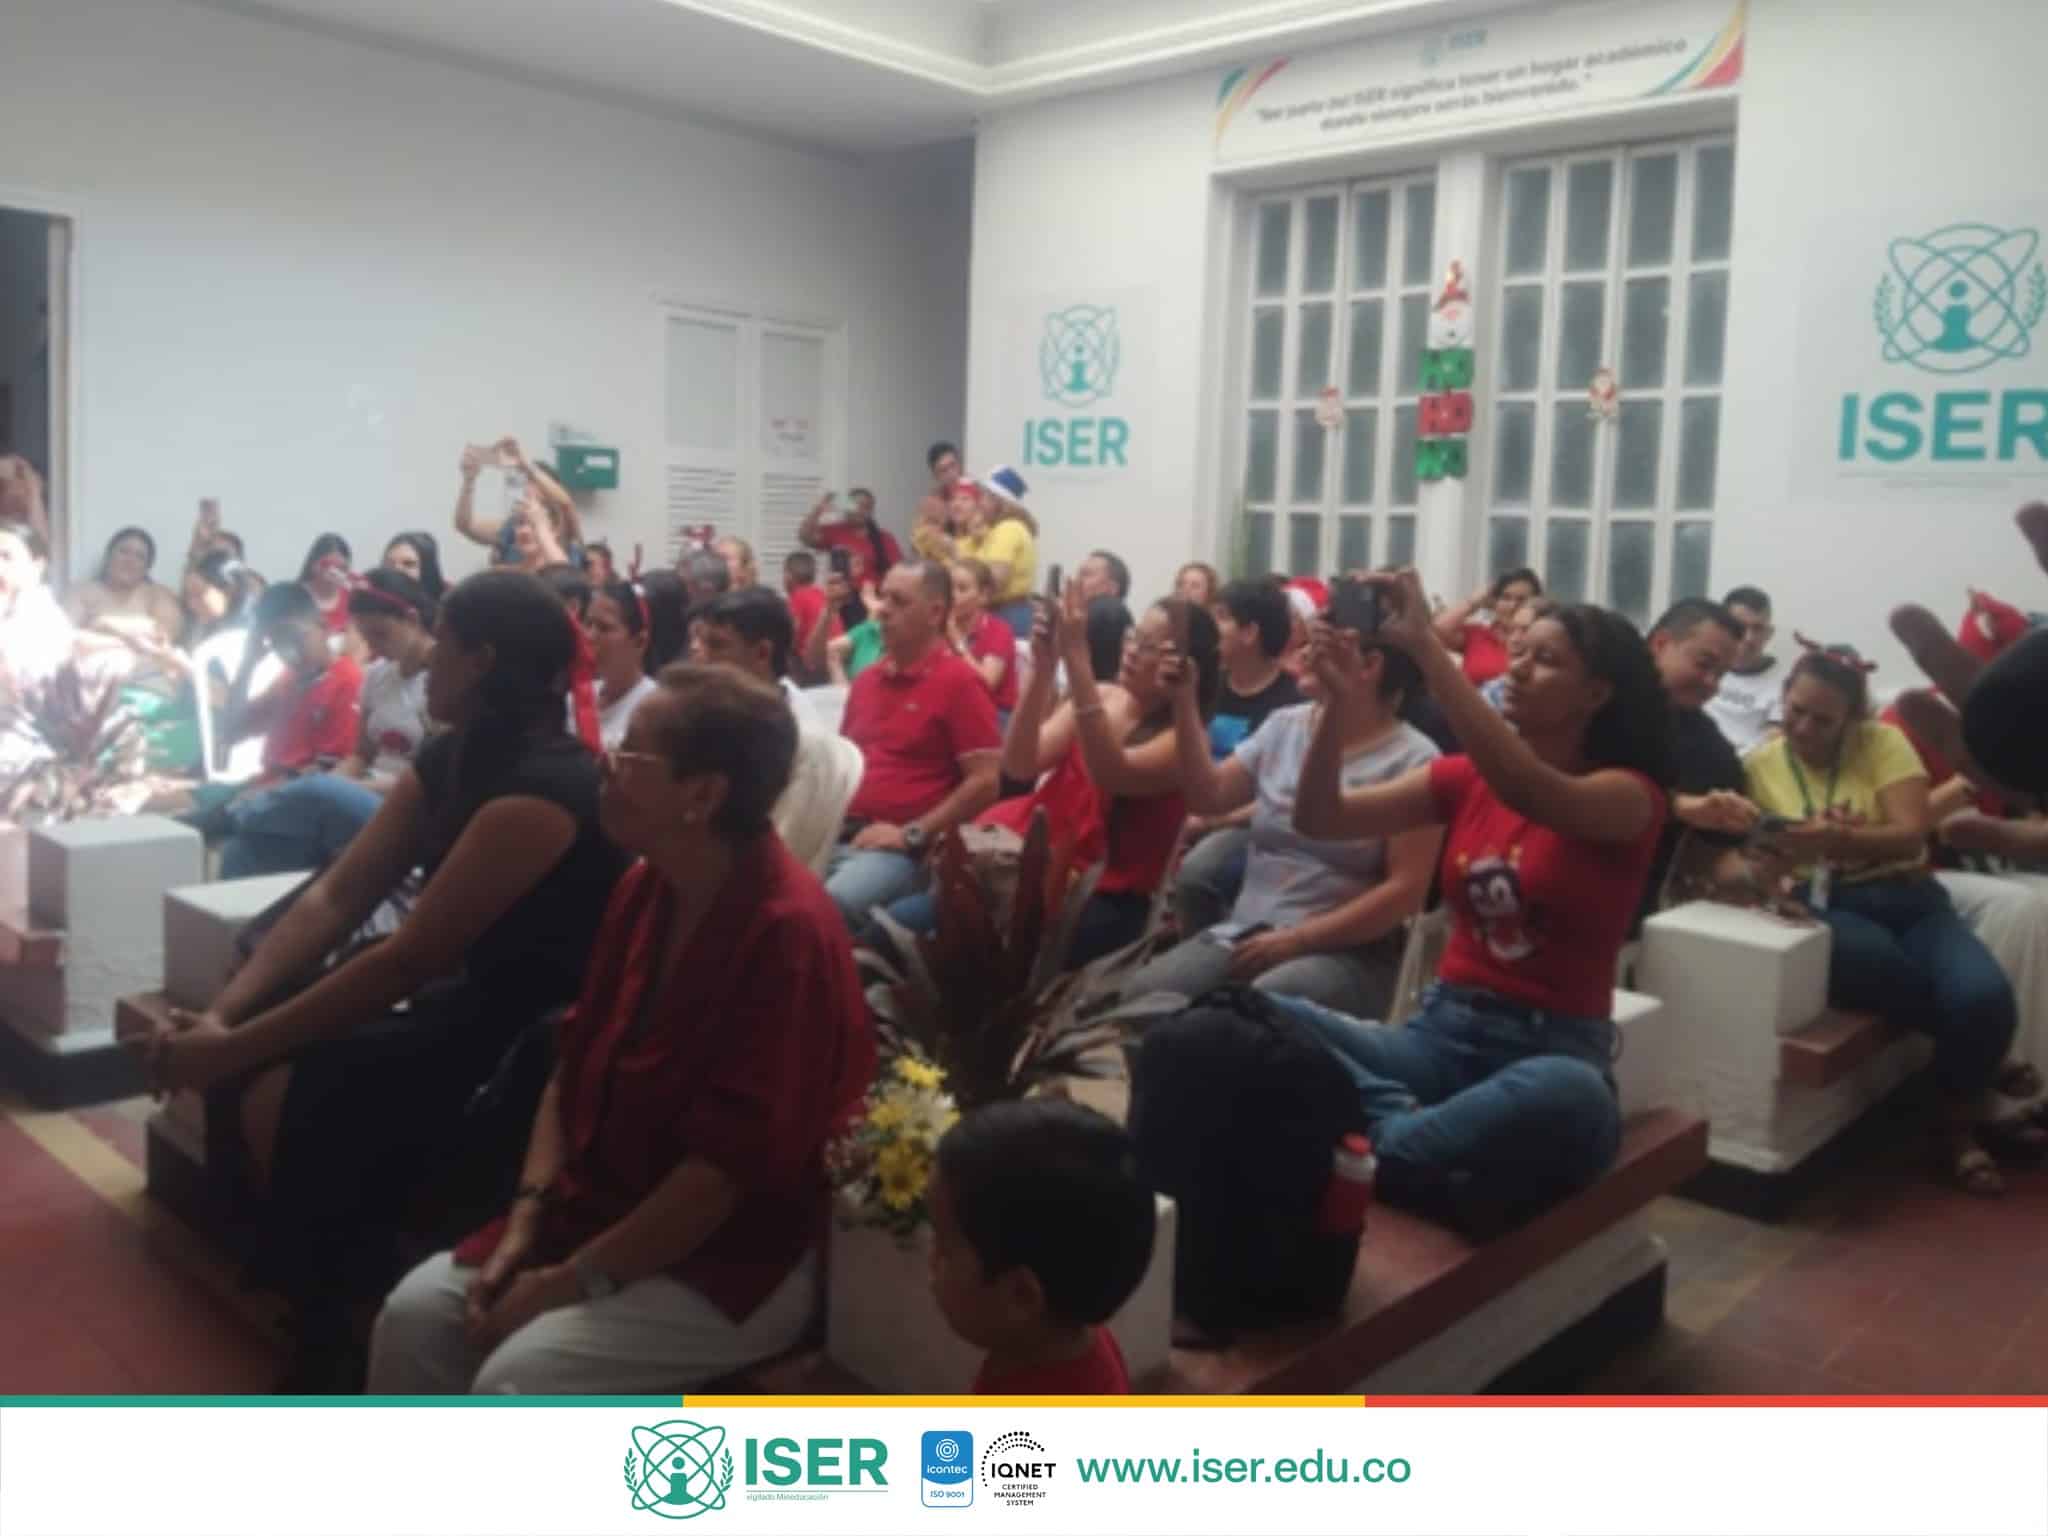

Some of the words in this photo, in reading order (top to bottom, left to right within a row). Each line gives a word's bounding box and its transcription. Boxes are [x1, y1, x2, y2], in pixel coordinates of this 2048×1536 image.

[1353, 87, 1386, 103] ISER
[1022, 416, 1129, 468] ISER
[1838, 389, 2048, 462] ISER
